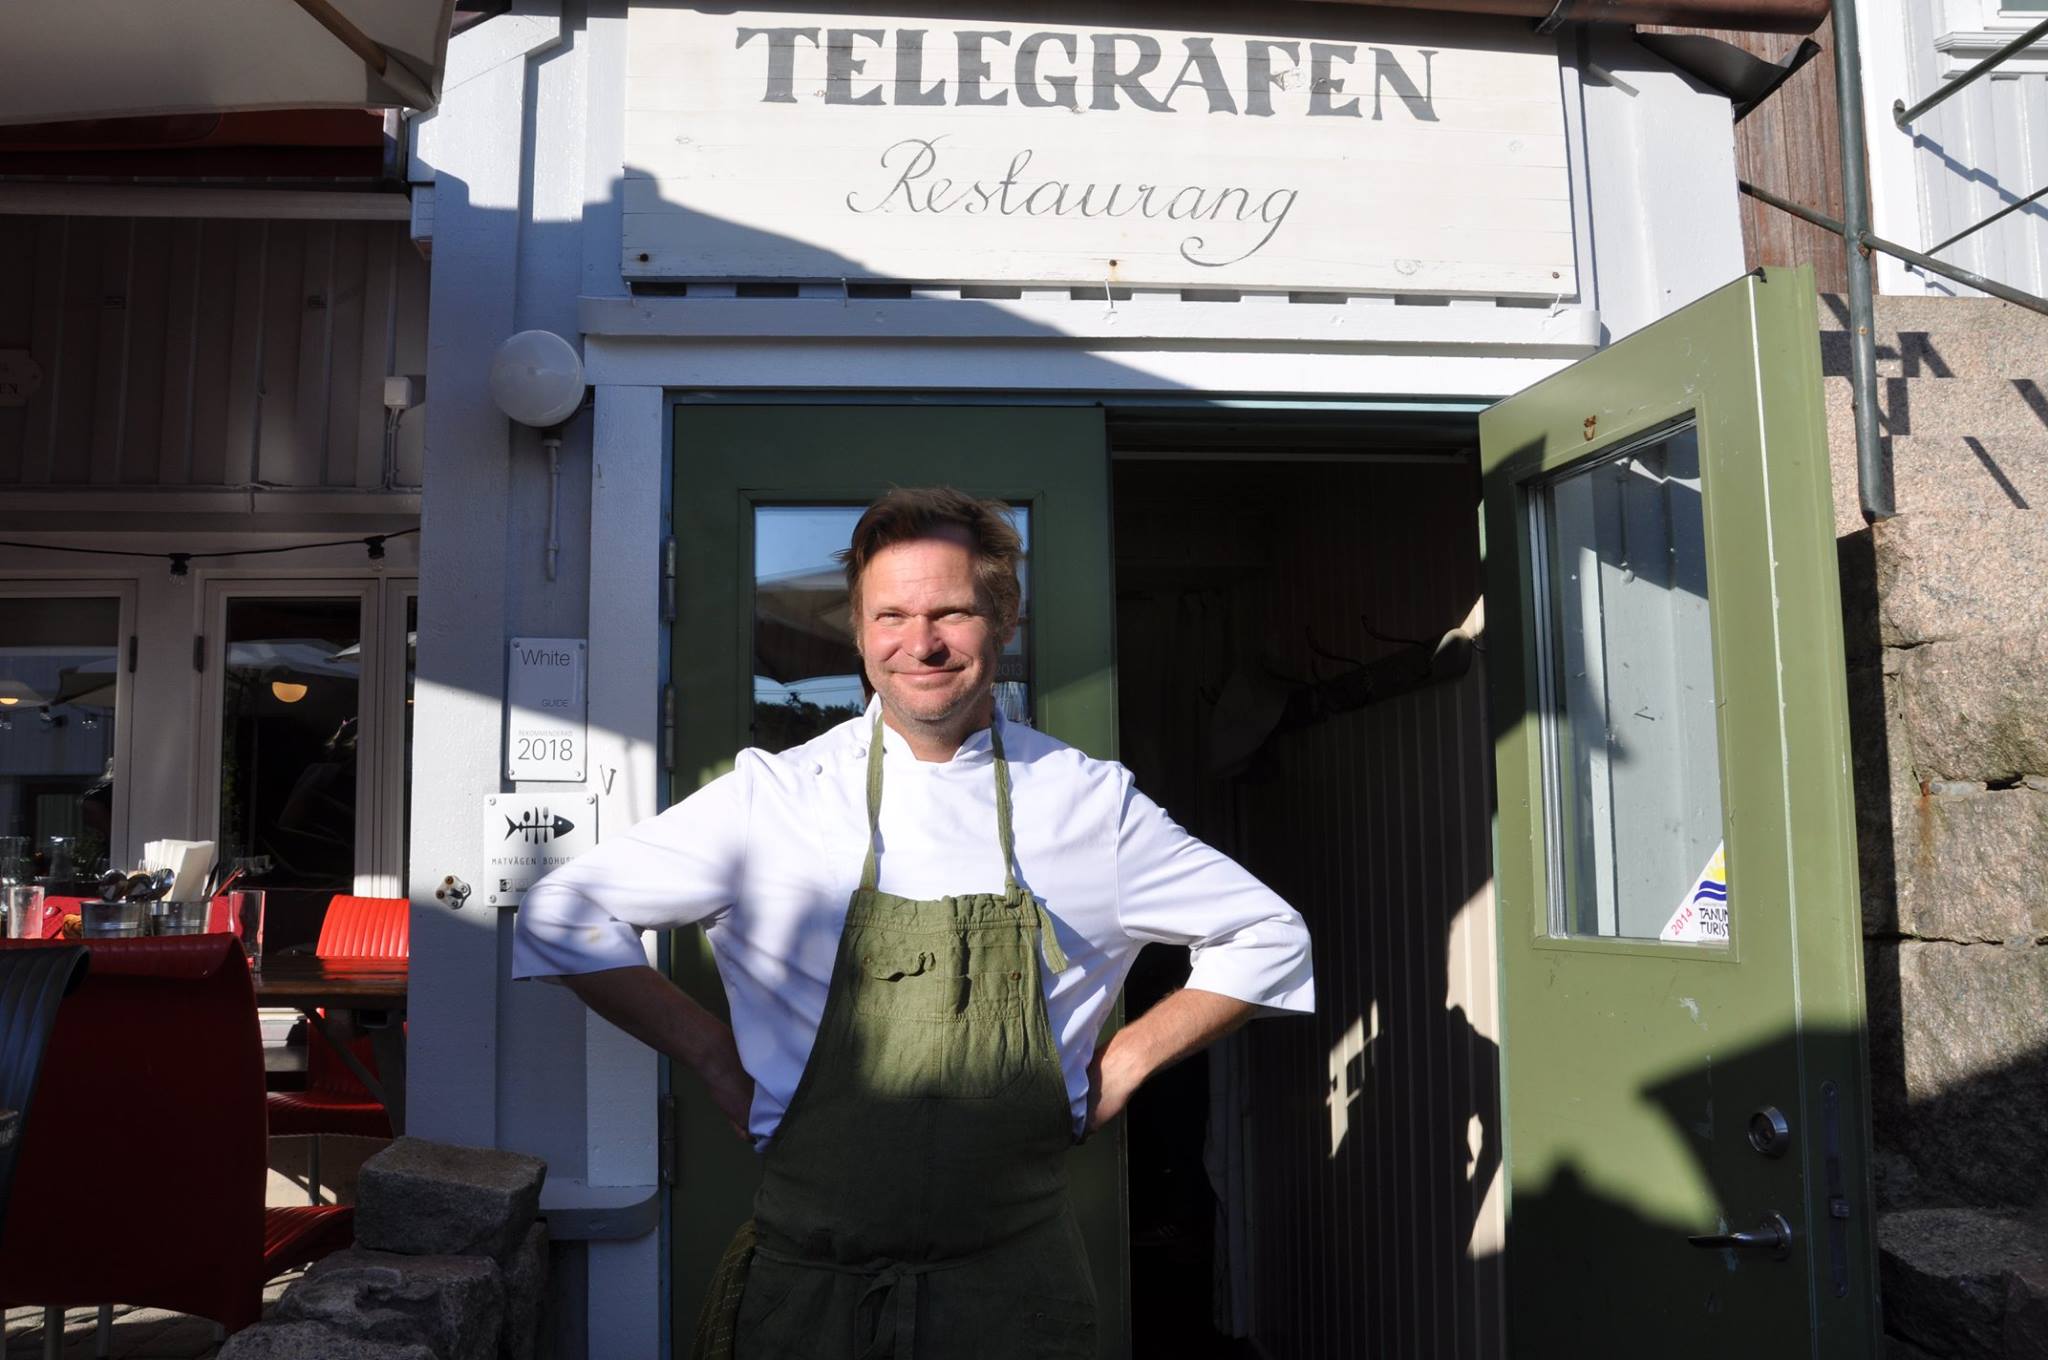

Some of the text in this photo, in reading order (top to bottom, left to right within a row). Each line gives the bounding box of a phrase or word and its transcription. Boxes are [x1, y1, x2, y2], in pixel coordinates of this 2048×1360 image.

[735, 27, 1440, 122] TELEGRAFEN
[846, 134, 1298, 267] Restaurang
[521, 649, 570, 666] White
[517, 739, 573, 761] 2018
[491, 856, 575, 866] MATVÄGEN BOHUS
[1671, 907, 1693, 935] 2014
